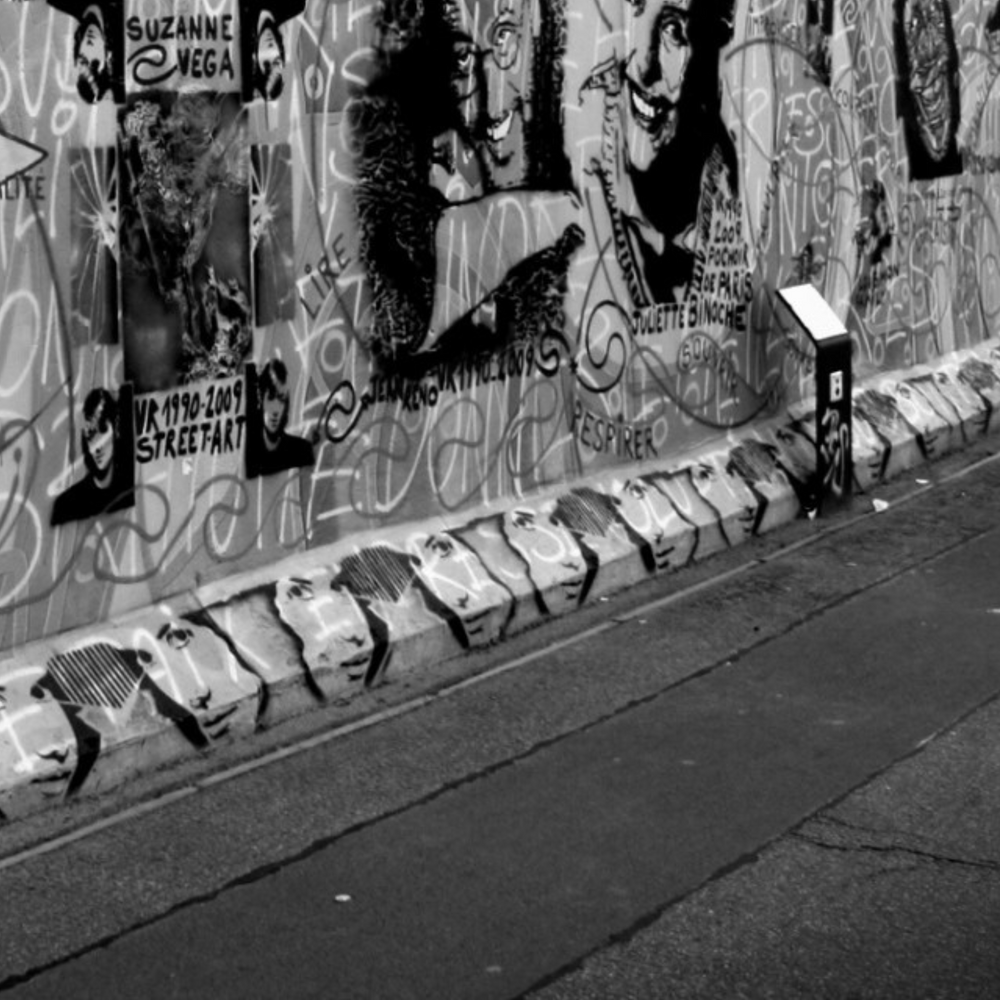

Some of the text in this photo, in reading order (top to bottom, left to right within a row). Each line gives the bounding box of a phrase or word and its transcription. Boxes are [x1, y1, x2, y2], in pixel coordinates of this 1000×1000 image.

[126, 13, 233, 43] SUZANNE
[177, 47, 234, 81] VEGA
[687, 293, 747, 332] BINOCHE
[134, 378, 244, 437] VR 1990-2009
[570, 400, 659, 460] RESPIRER
